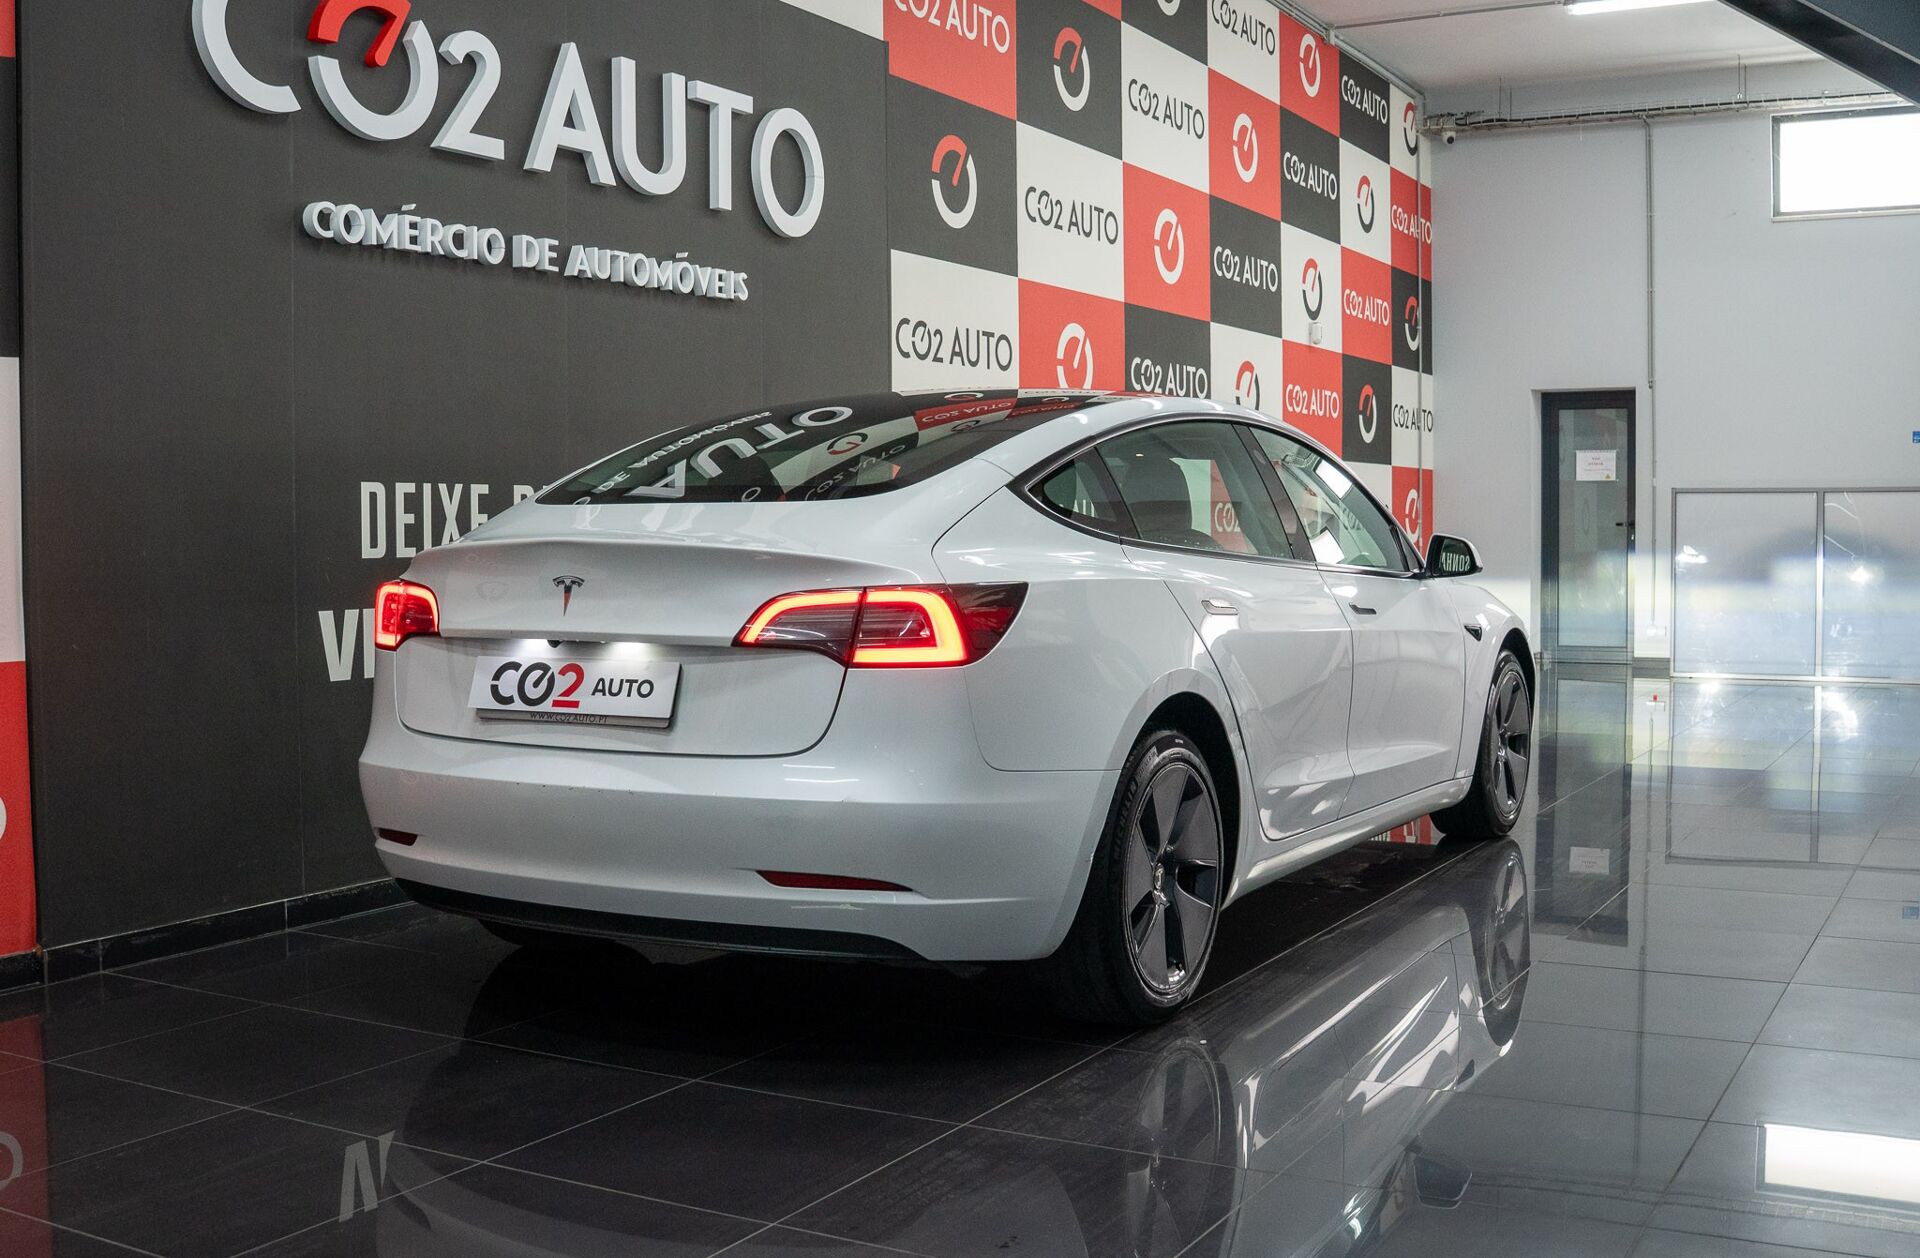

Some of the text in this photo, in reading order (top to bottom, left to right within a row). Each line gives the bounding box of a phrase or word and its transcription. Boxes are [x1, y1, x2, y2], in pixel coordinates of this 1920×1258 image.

[945, 0, 1010, 53] AUTO
[1212, 0, 1275, 56] CO2 AUTO
[192, 0, 825, 238] CO2 AUTO
[1128, 78, 1204, 140] CO2 AUTO
[1341, 75, 1388, 125] CO2 AUTO
[1283, 151, 1338, 200] CO2 AUTO
[1025, 186, 1118, 244] CO2 AUTO
[1391, 204, 1409, 235] CO2
[302, 201, 749, 301] COMÉRCIO DE AUTOMÓVEIS
[1214, 245, 1279, 292] CO2 AUTO
[1344, 288, 1390, 326] CO2 AUTO
[896, 317, 1013, 372] CO2 AUTO
[1130, 356, 1208, 399] CO2 AUTO
[1285, 383, 1340, 419] CO2 AUTO
[1393, 404, 1410, 429] CO2
[360, 481, 490, 559] DEIXE
[490, 660, 655, 709] CO2 AUTO
